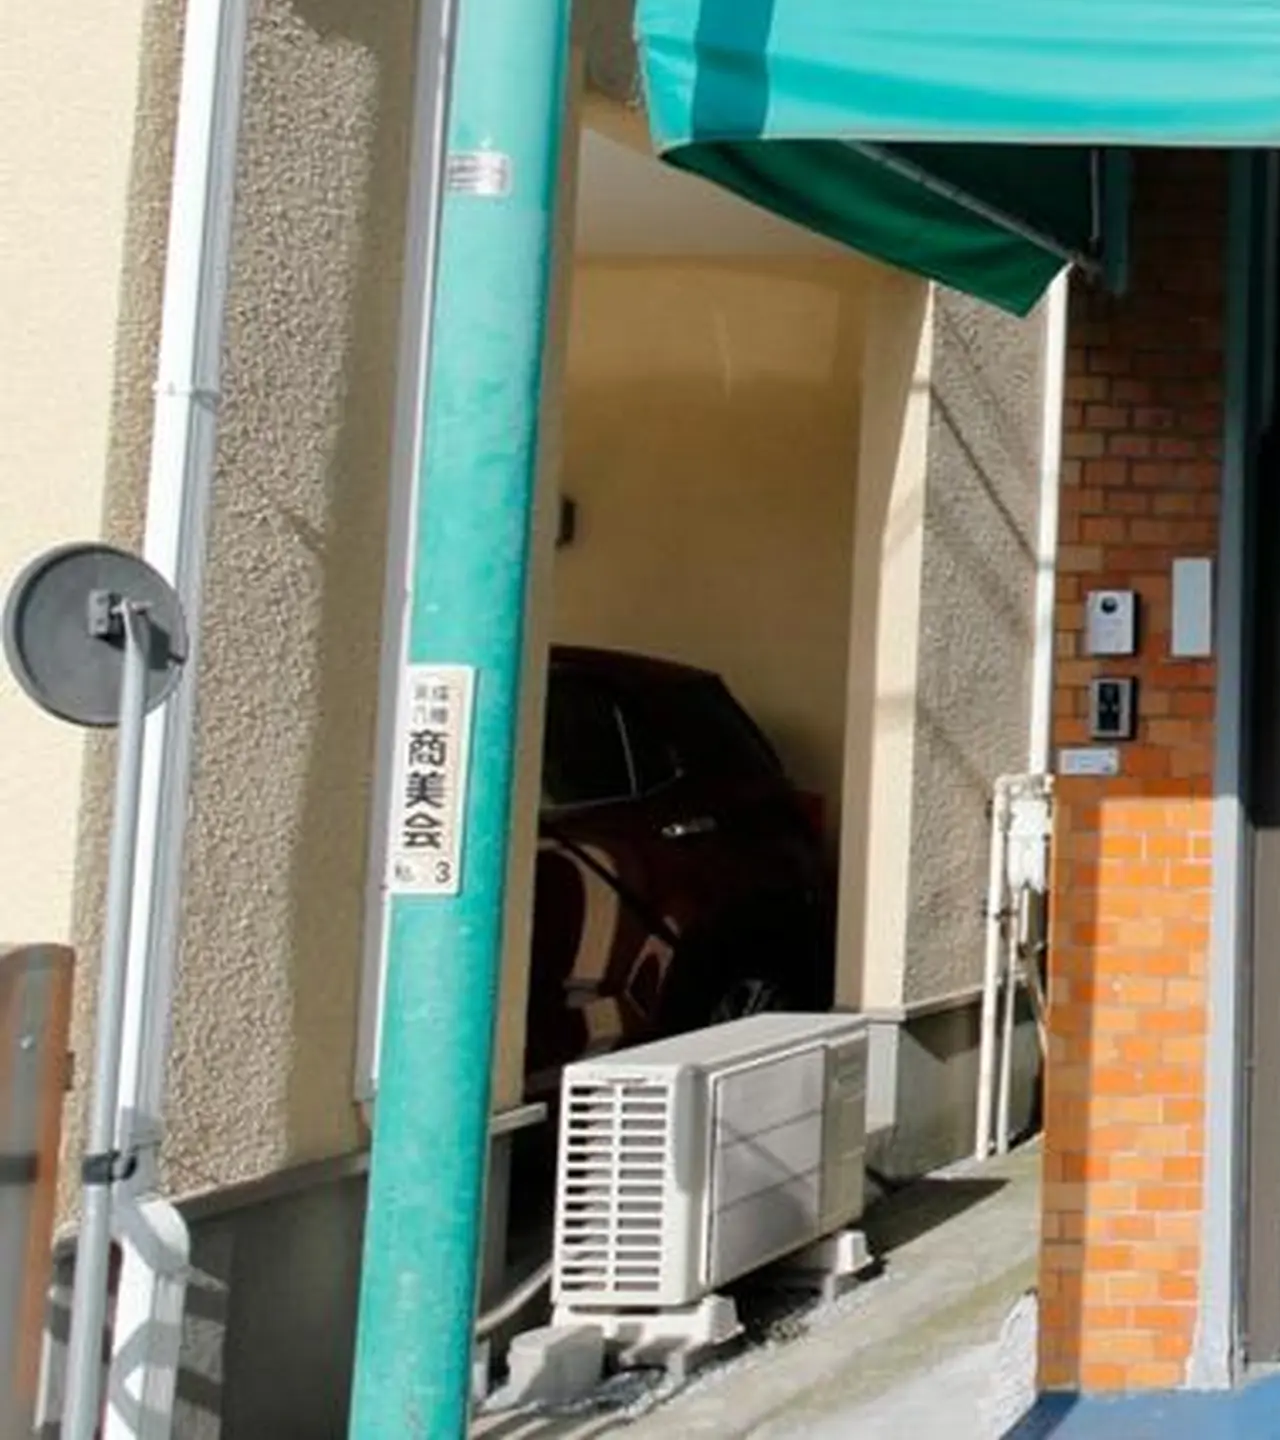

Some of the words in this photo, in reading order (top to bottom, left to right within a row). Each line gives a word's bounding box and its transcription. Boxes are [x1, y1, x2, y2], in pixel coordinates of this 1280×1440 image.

[404, 729, 449, 850] 商美会
[435, 860, 452, 884] 3
